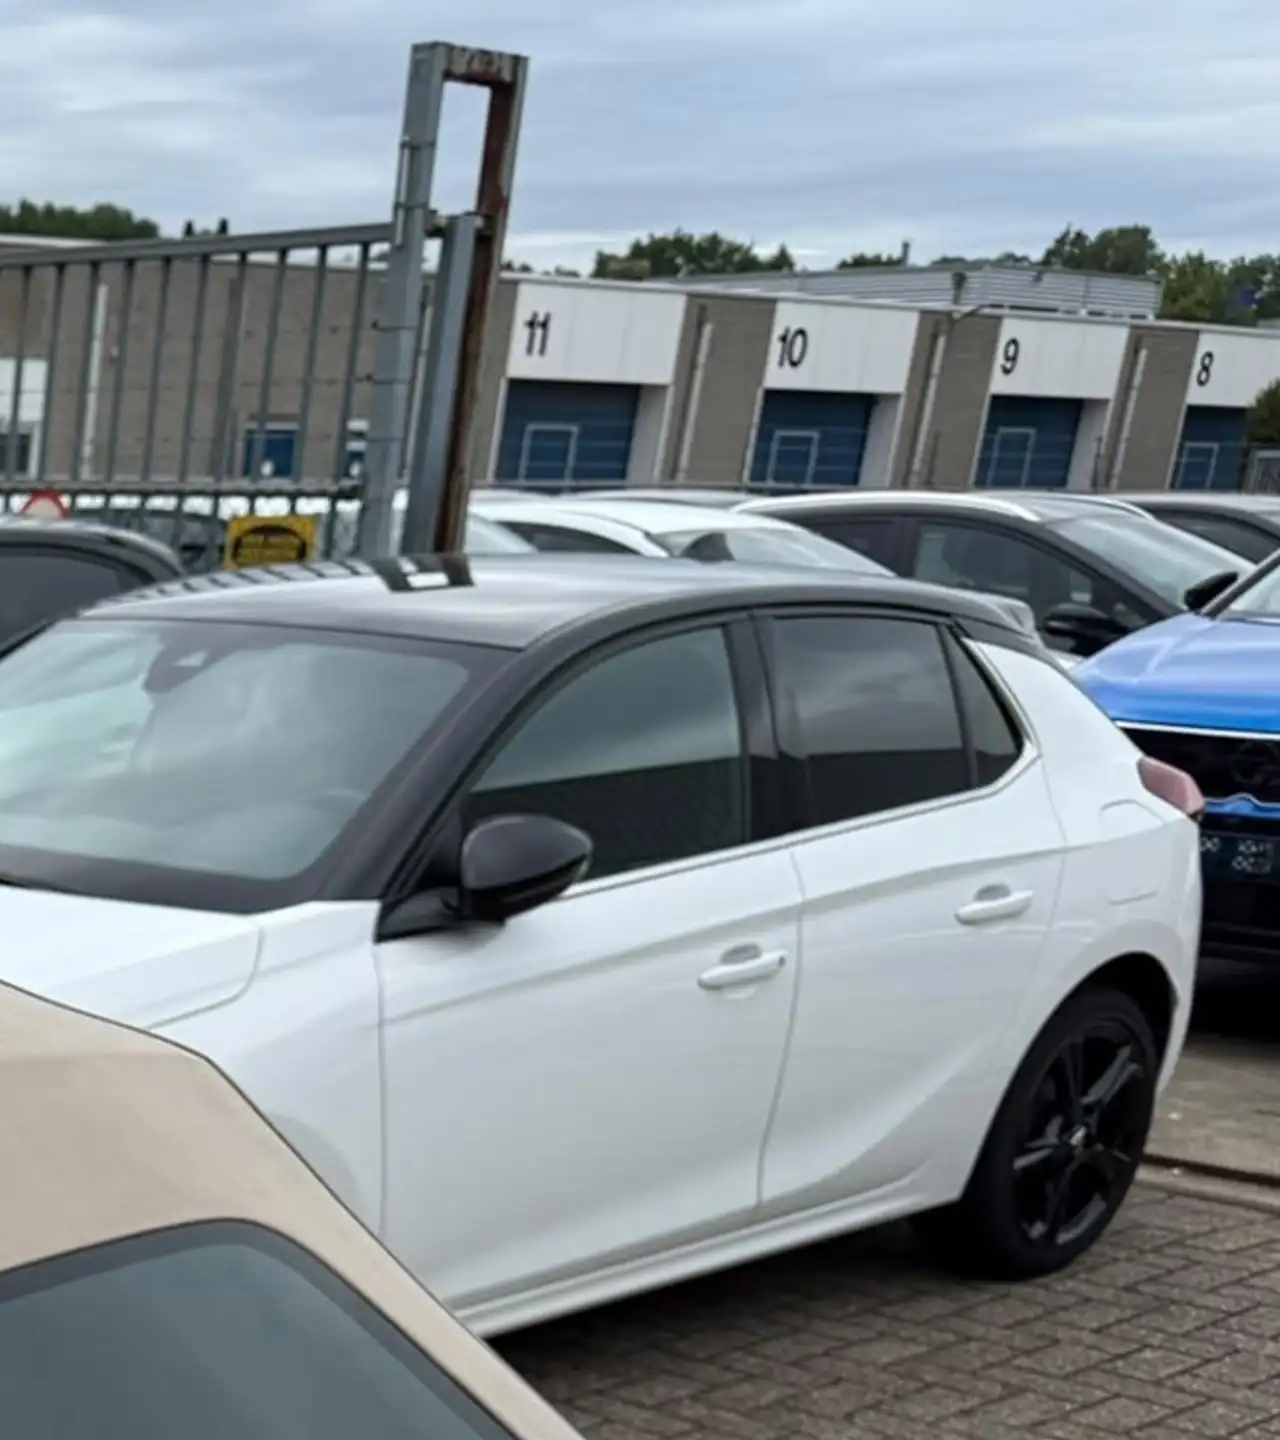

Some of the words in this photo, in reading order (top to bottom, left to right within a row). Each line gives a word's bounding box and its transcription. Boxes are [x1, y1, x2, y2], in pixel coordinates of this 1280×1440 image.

[524, 310, 551, 357] 11
[778, 326, 808, 369] 10
[1000, 337, 1020, 376] 9
[1196, 350, 1214, 388] 8
